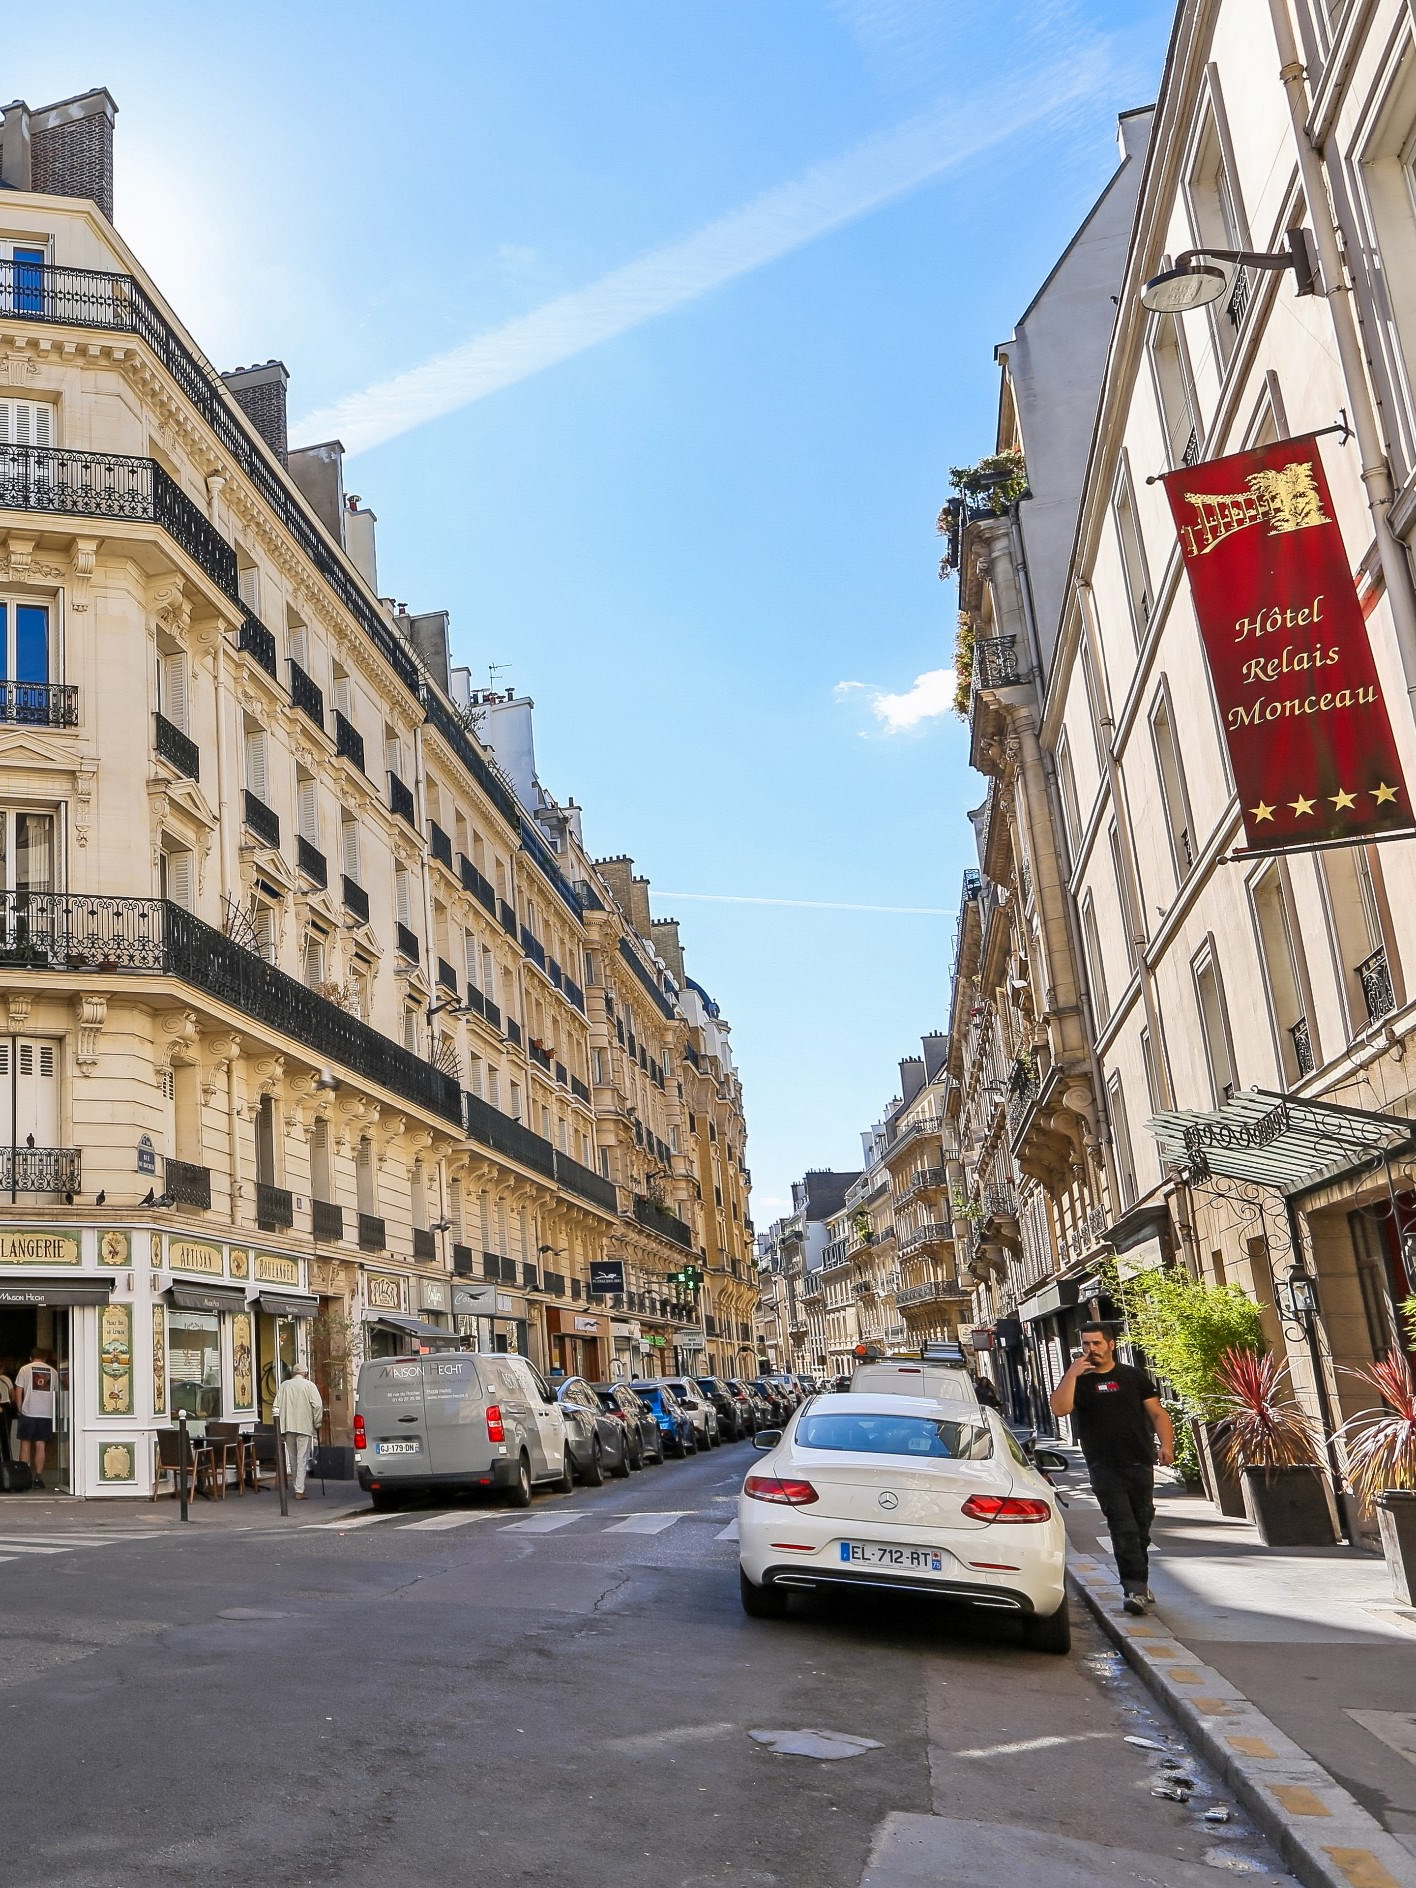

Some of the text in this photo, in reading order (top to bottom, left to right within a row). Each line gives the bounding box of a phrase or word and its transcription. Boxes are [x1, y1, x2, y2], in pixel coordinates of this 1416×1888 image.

[1234, 595, 1325, 643] Hôtel
[1242, 643, 1340, 684] Relais
[1228, 685, 1379, 731] Monceau
[259, 1259, 294, 1281] BOULANGER
[851, 1545, 931, 1567] EL-712-RT
[932, 1561, 941, 1569] 75
